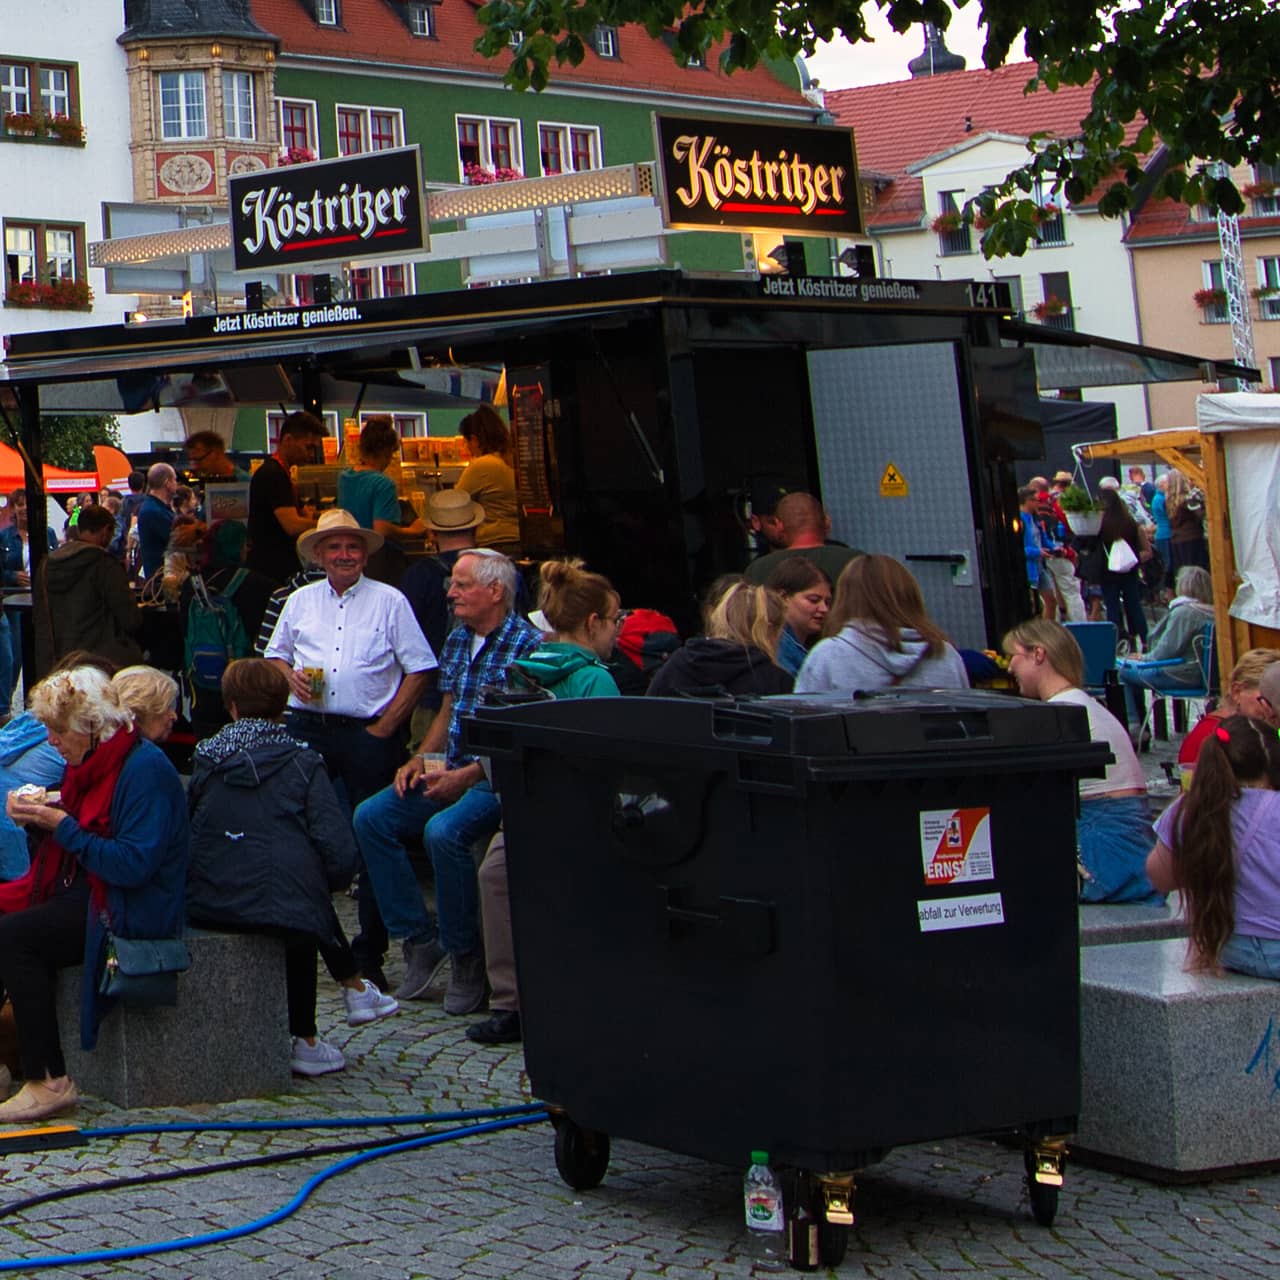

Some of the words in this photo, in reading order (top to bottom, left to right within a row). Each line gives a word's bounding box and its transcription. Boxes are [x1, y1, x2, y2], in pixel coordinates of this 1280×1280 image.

[673, 135, 846, 215] Köstritzer
[242, 183, 410, 255] Köstritzer
[763, 277, 794, 296] Jetzt
[797, 278, 858, 298] Köstritzer
[860, 282, 920, 301] genießen.
[965, 284, 998, 308] 141
[213, 316, 240, 333] Jetzt
[243, 311, 300, 330] Köstritzer
[302, 305, 362, 328] genießen.
[927, 861, 967, 879] ERNST
[919, 906, 942, 920] abfall
[944, 906, 957, 919] zur
[958, 902, 1002, 917] Verwertung
